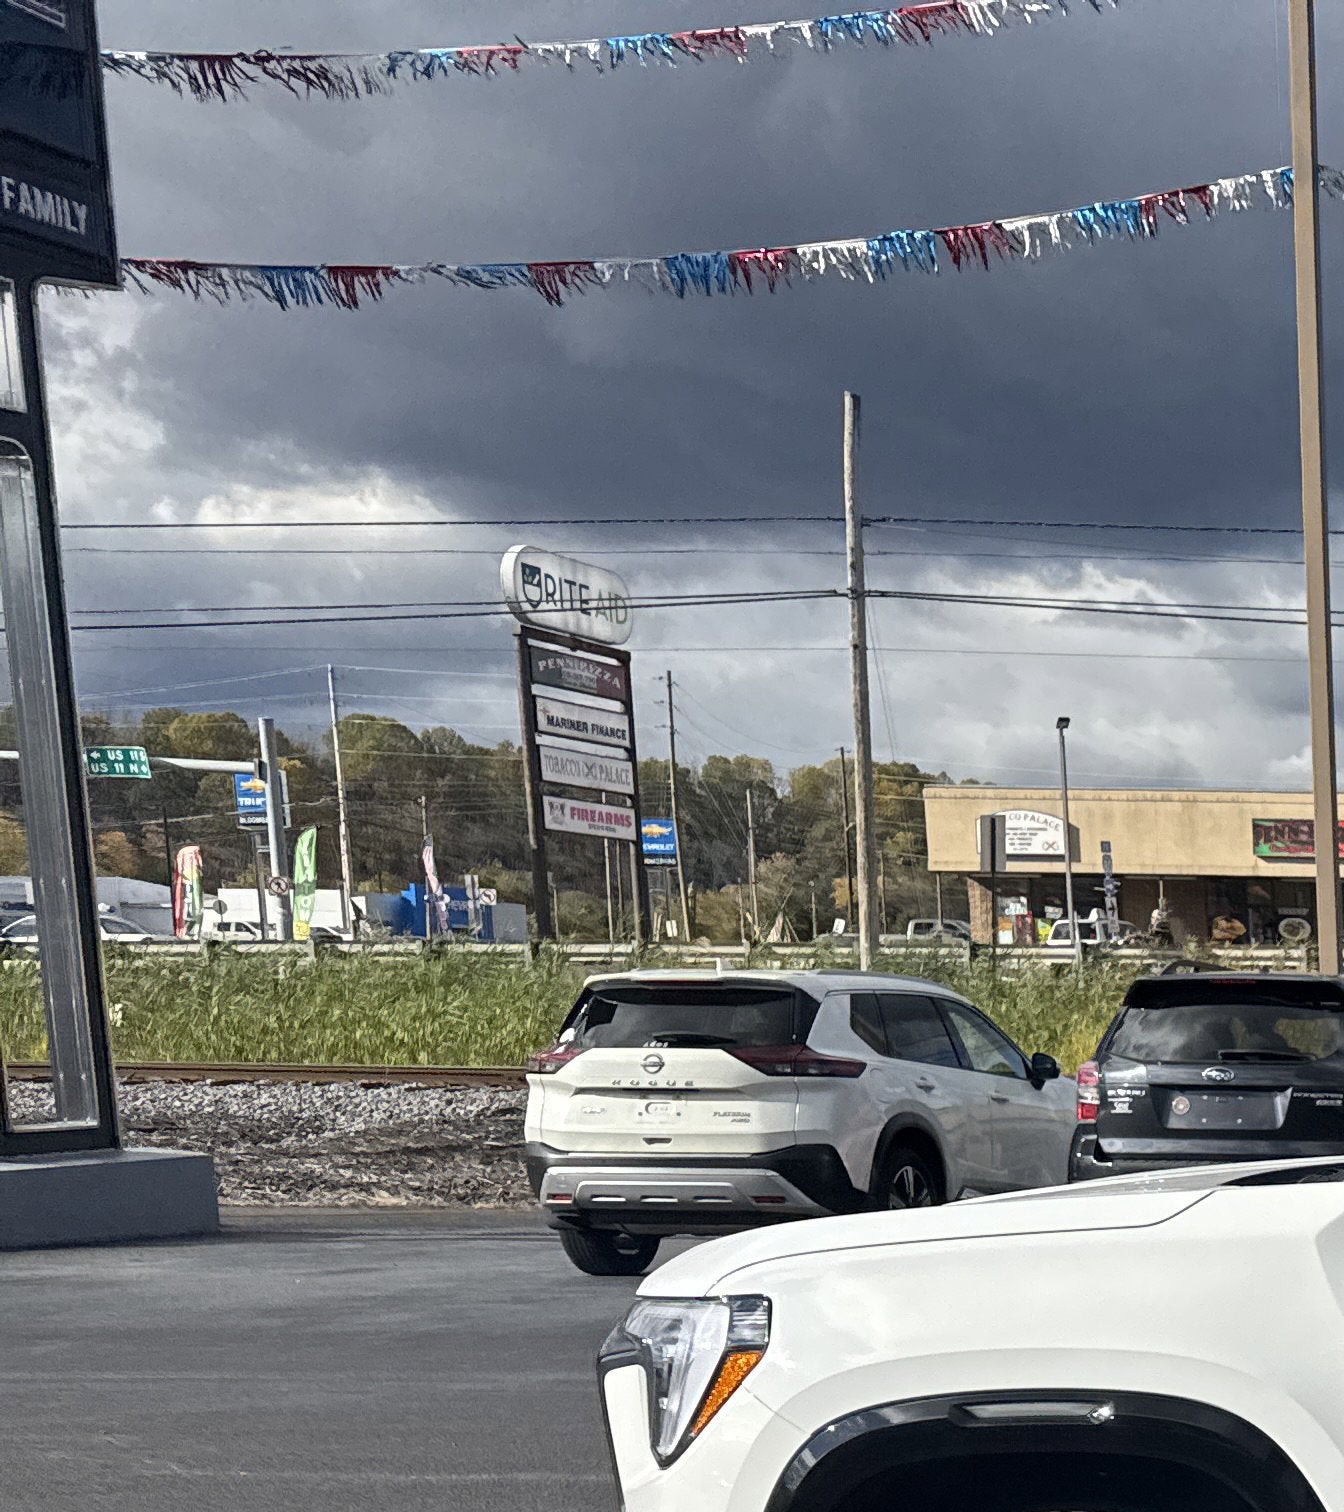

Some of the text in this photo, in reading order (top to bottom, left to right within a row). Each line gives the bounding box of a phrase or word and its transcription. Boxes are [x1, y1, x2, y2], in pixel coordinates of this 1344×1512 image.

[1, 175, 87, 235] FAMILY
[544, 573, 628, 624] RITE AID
[547, 714, 627, 741] MARINER FINANCE
[107, 749, 124, 761] US
[91, 763, 139, 773] US 11 N
[600, 765, 631, 786] PALACE
[569, 806, 632, 828] FIREARMS
[1023, 813, 1061, 832] PALACE
